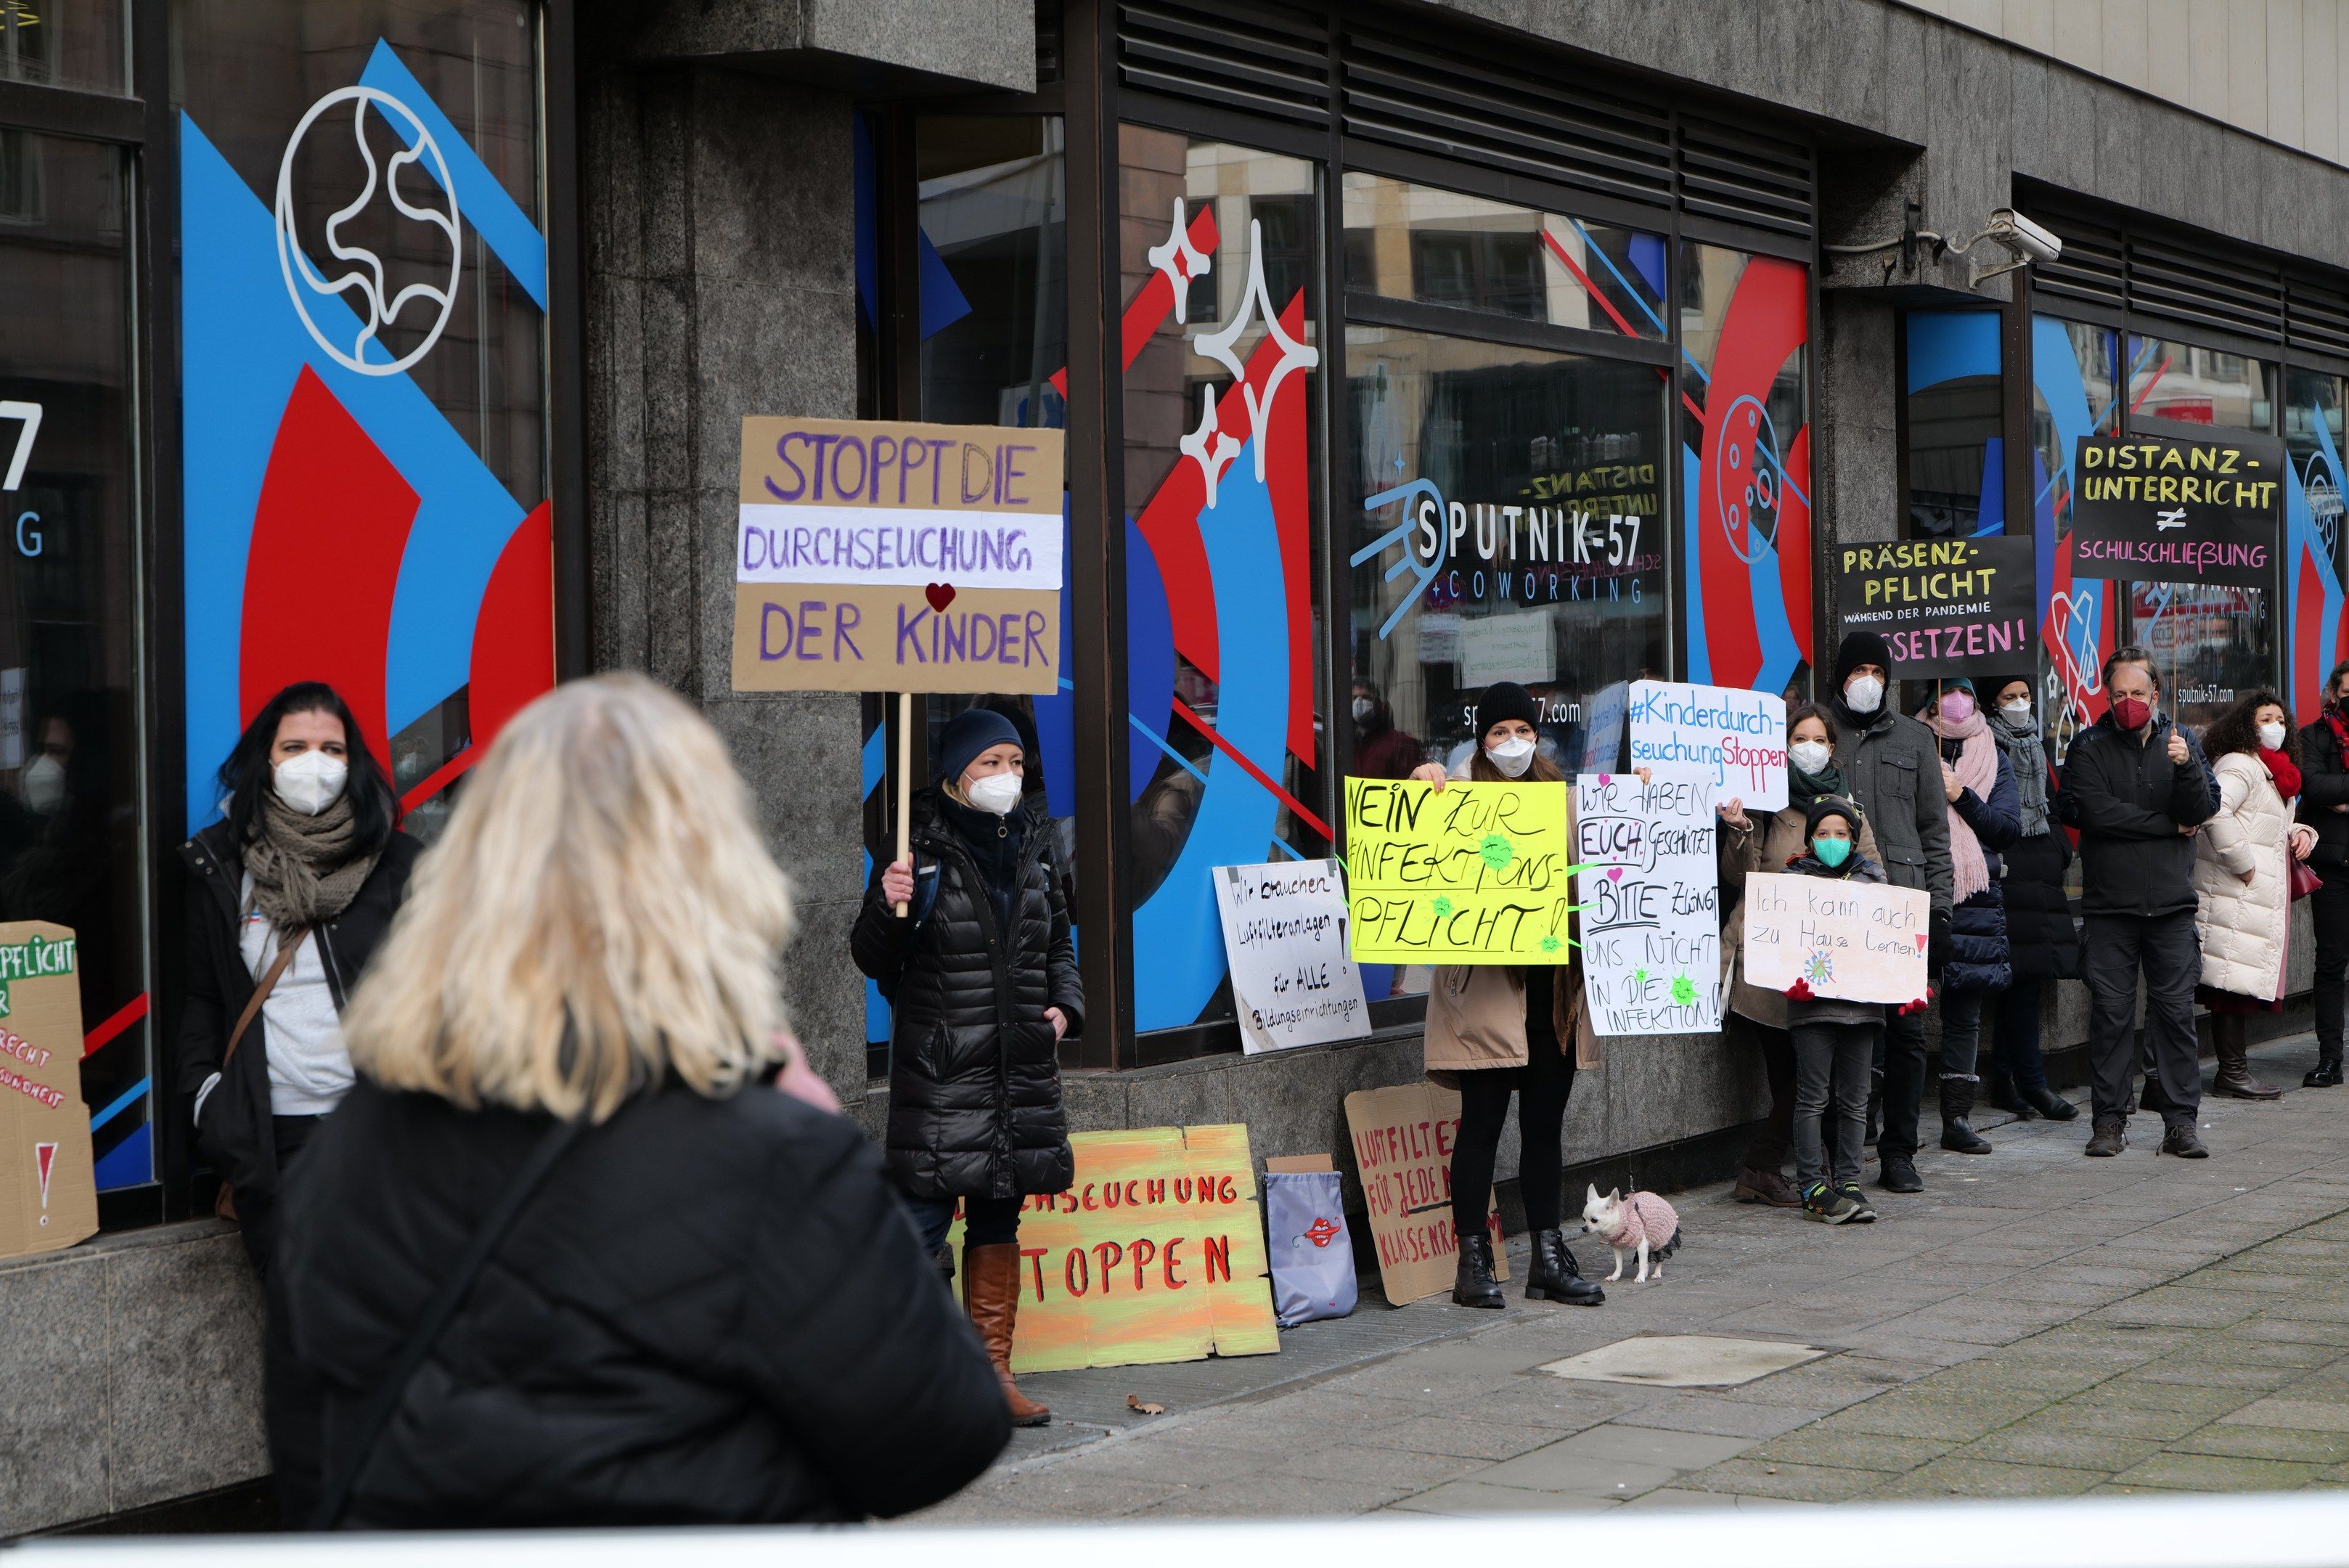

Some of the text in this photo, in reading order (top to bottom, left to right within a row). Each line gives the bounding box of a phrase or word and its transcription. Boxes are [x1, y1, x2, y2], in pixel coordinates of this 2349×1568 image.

[764, 431, 1037, 505] STOPPT DIE
[2085, 445, 2259, 474] DISTANZ-
[2085, 476, 2277, 509] UNTERRICHT
[743, 526, 1032, 571] DURCHSEUCHUNG
[1419, 499, 1641, 566] SPUTNIK-57
[1844, 541, 1979, 573] PRÄSENZ-
[1449, 571, 1641, 604] COWORKING
[1865, 568, 1996, 605] PFLICHT
[1844, 601, 1991, 624] WÄHREND DER PANDEMIE
[2176, 597, 2266, 619] COWORKING
[759, 602, 864, 662] DER
[1630, 689, 1785, 735] #Kinderdurch-
[2178, 683, 2234, 708] sputnik-57.com
[1630, 782, 1712, 817] HABEN
[1581, 822, 1642, 859] EUCH
[1230, 871, 1331, 908] Wir brauchen
[1757, 884, 1786, 911] Ich
[1871, 901, 1916, 928] auch
[1237, 912, 1331, 950] Luftfilteranlagen
[1800, 919, 1848, 947] Hause
[1586, 939, 1623, 969] UNS
[1274, 963, 1331, 999] für ALLE
[1252, 998, 1358, 1032] Bildungseinrichtungen
[1367, 1174, 1393, 1218] FÜR
